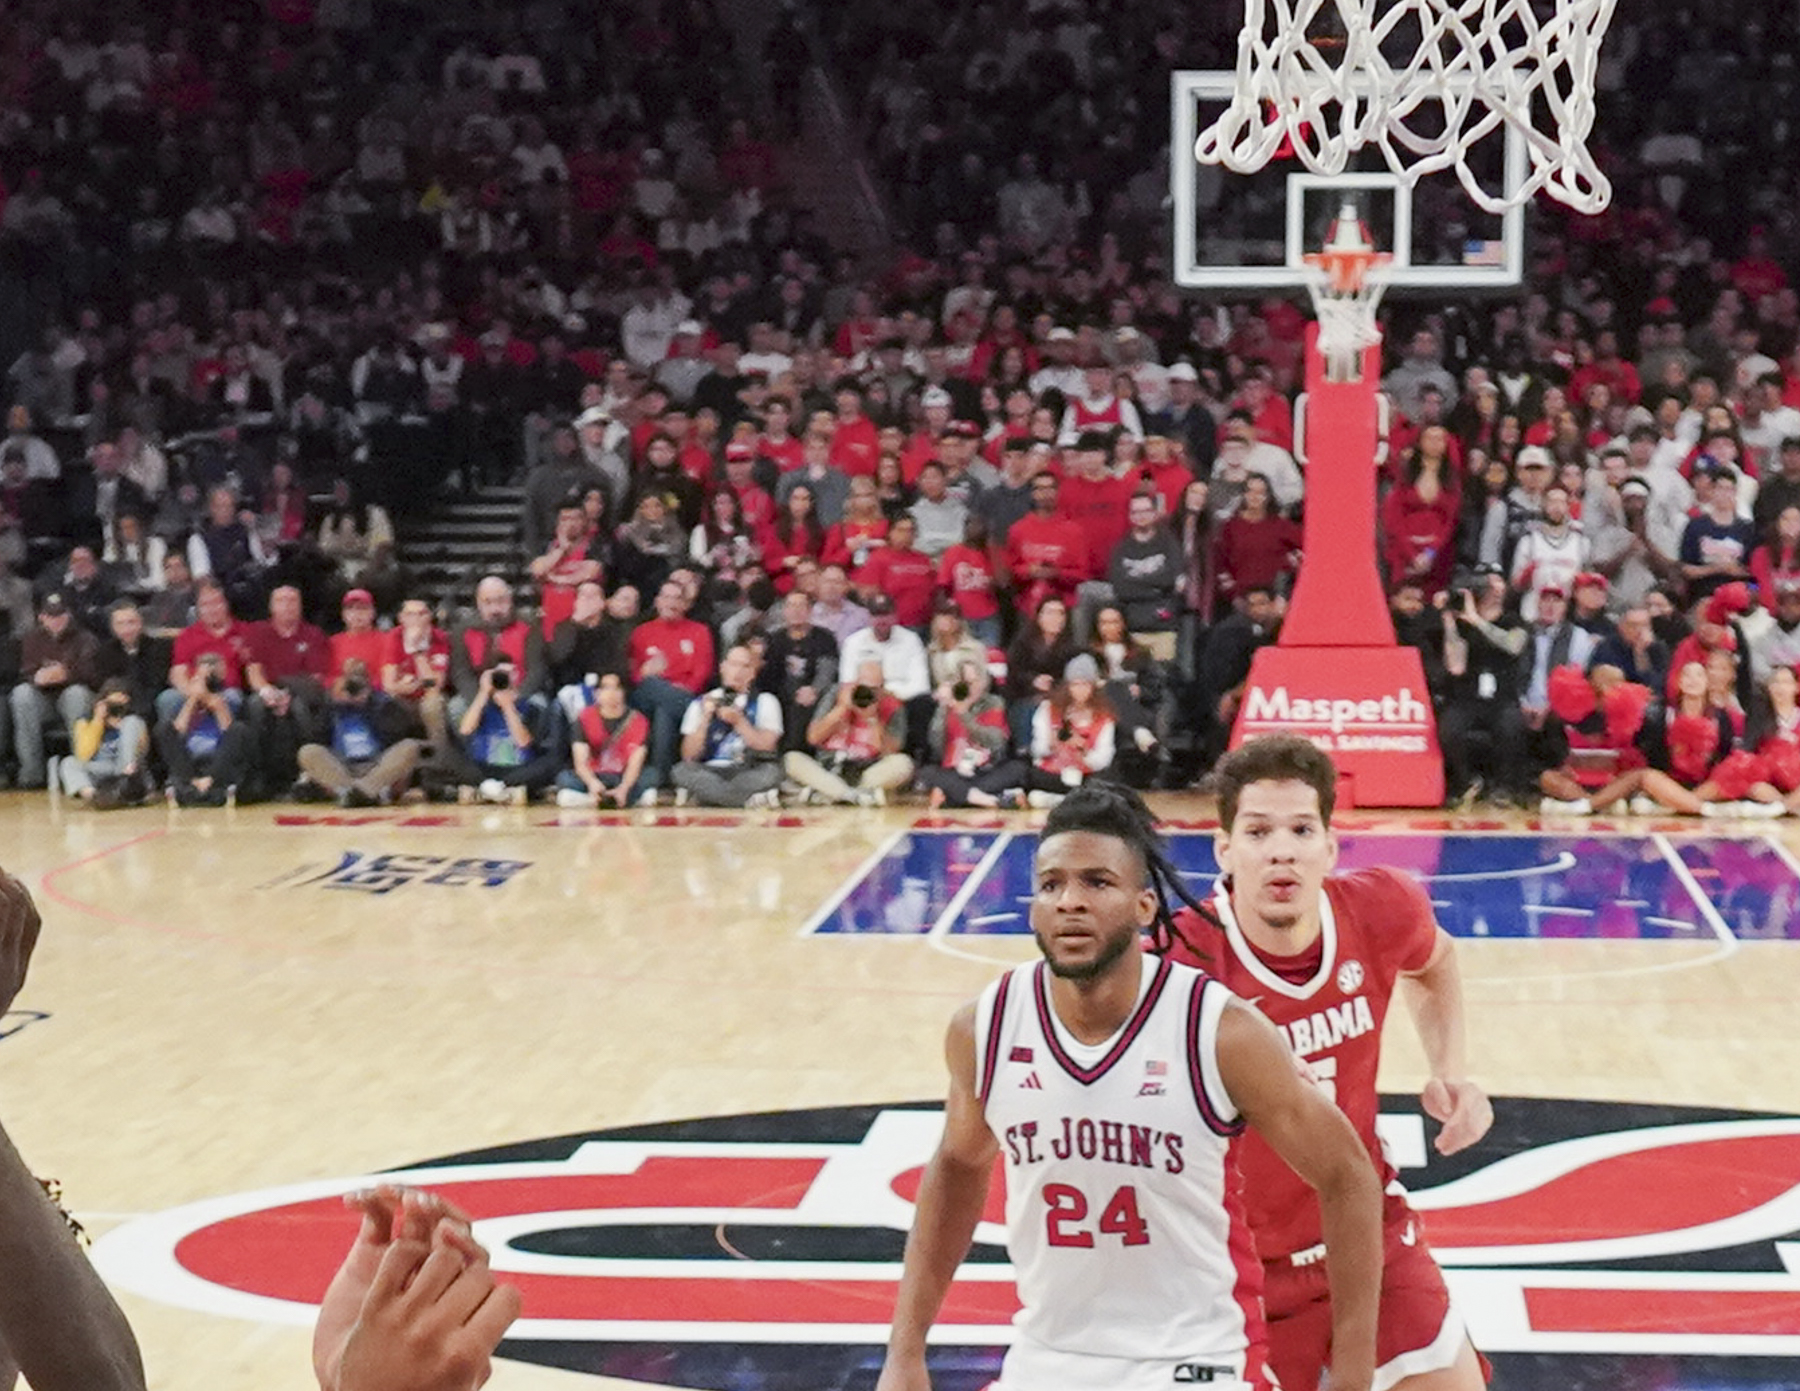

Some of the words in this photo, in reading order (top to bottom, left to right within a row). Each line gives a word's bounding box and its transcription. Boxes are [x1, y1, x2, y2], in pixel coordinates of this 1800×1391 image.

[1244, 686, 1427, 734] Maspeth
[1006, 1120, 1044, 1166] ST.
[1051, 1117, 1185, 1174] JOHN'S
[1042, 1182, 1150, 1249] 24
